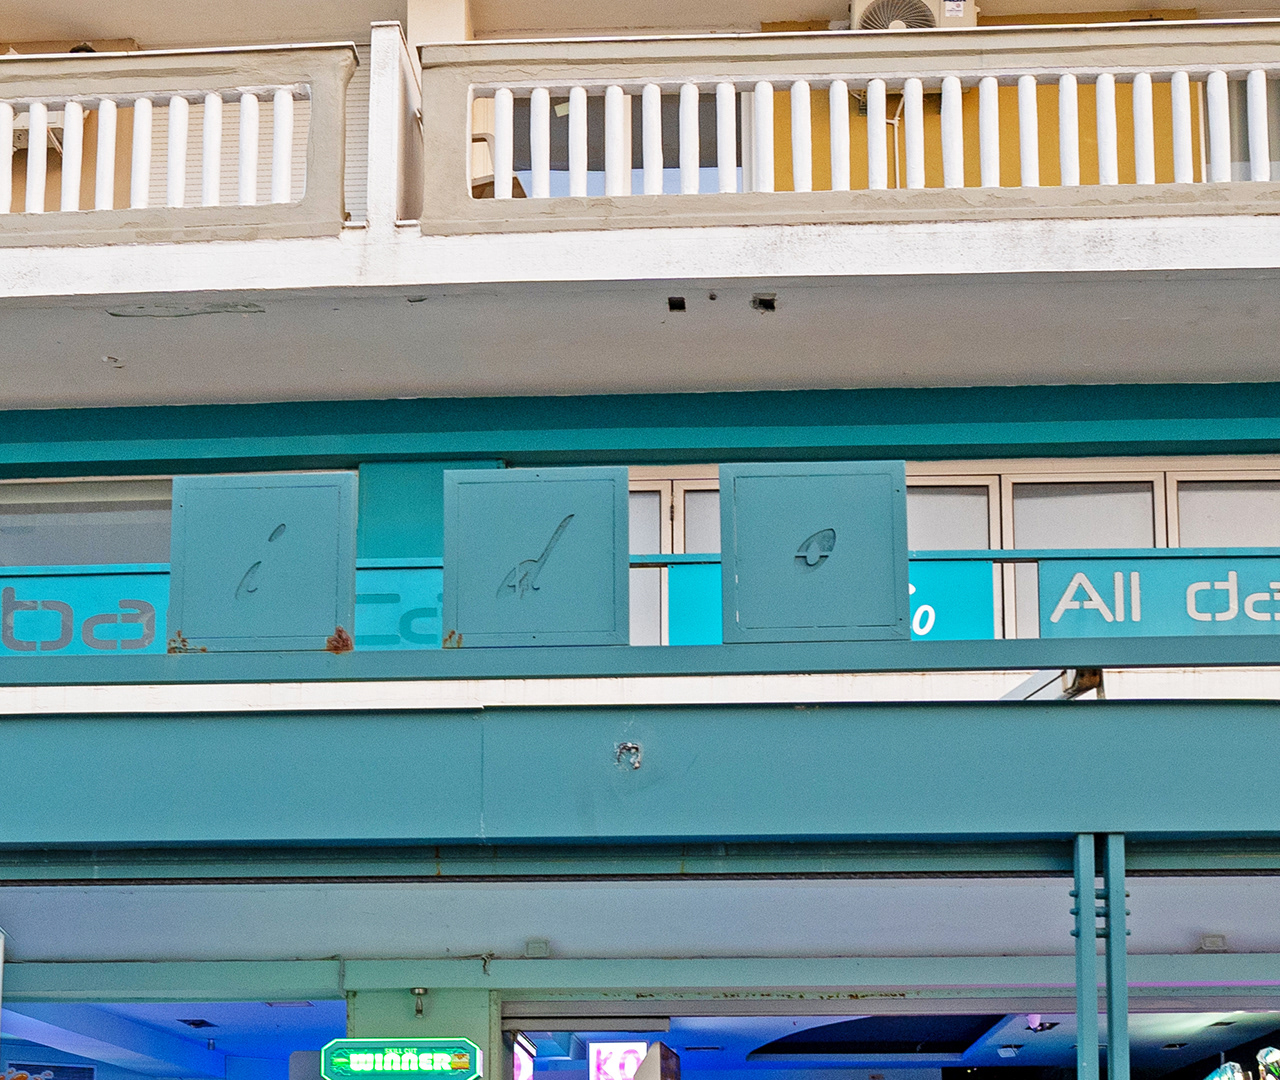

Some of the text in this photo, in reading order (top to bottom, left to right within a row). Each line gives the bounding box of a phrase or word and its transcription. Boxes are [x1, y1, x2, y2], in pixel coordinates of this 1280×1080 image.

[1, 586, 156, 652] ba
[1049, 570, 1142, 624] All
[349, 1053, 453, 1071] WINNER
